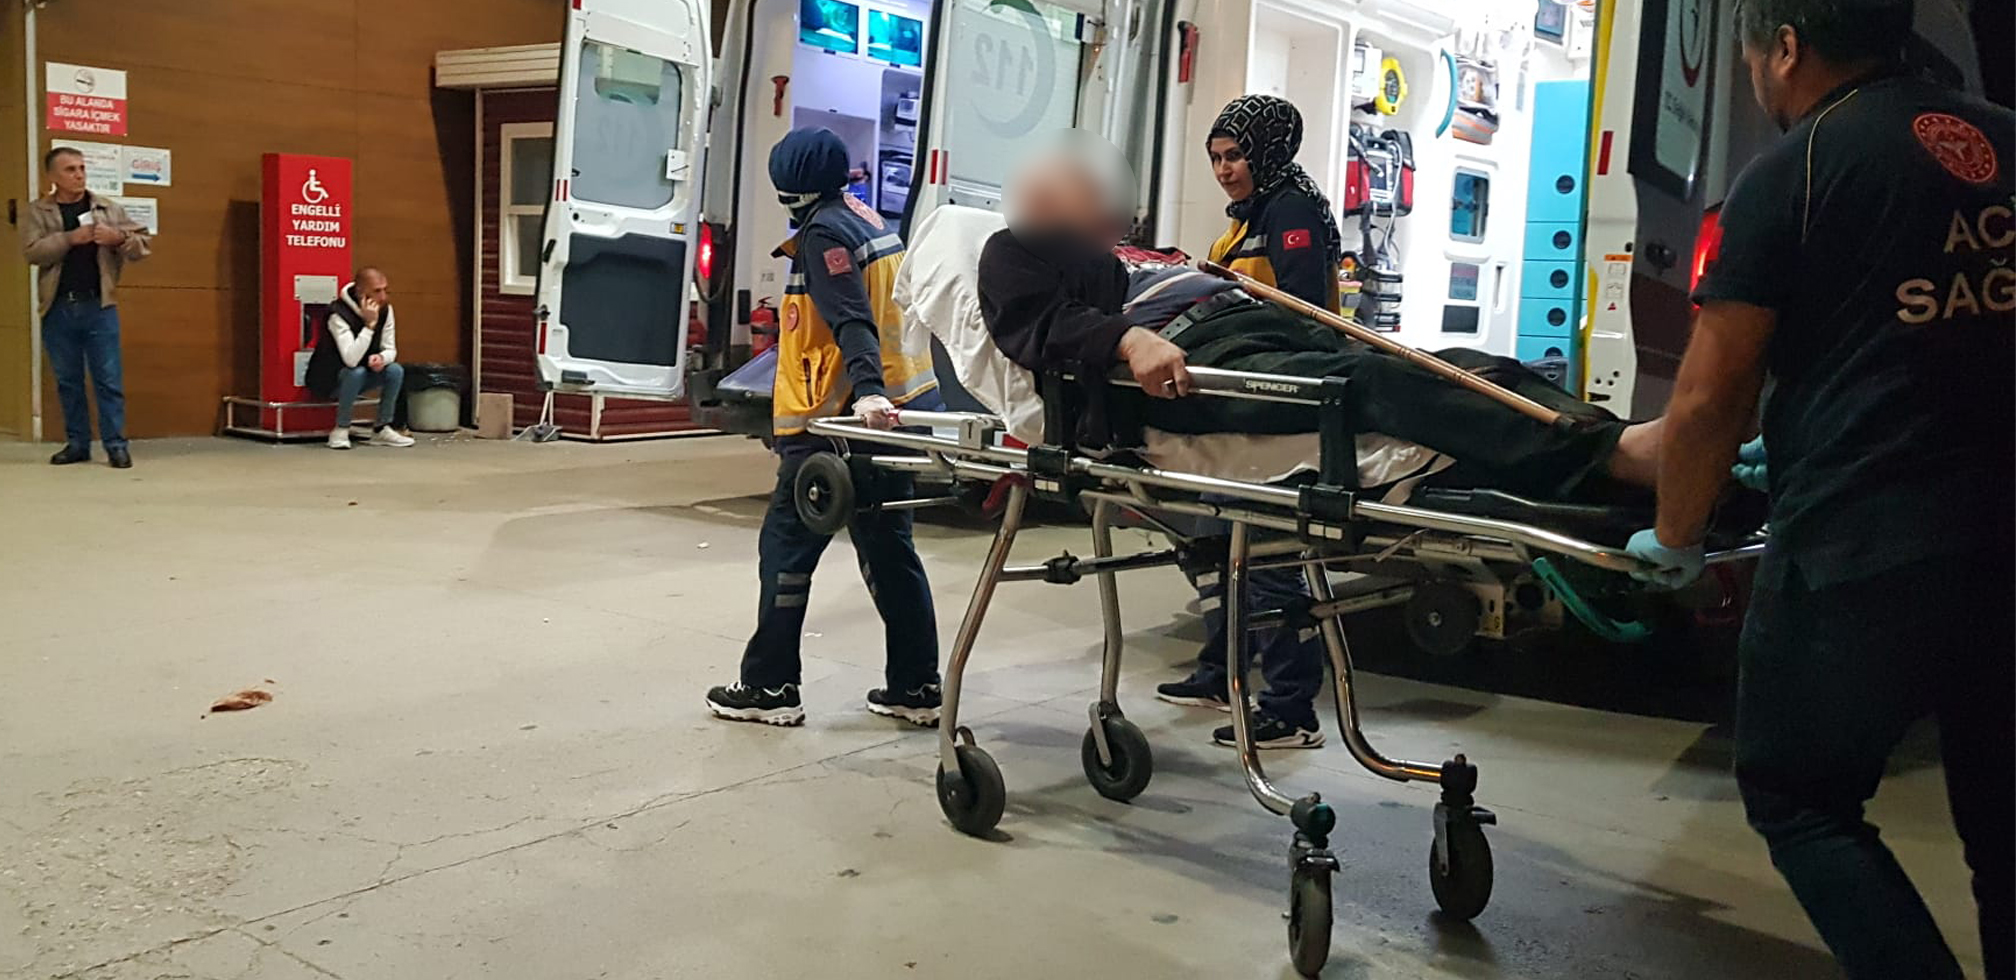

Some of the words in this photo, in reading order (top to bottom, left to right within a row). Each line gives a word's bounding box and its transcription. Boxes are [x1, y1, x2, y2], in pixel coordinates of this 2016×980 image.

[60, 95, 74, 105] BU
[75, 97, 114, 109] ALANDA
[53, 107, 90, 119] SİGARA
[91, 110, 121, 123] İÇMEK
[64, 120, 111, 133] YASAKTIR
[291, 203, 341, 217] ENGELLİ
[292, 219, 340, 233] YARDIM
[1943, 205, 2016, 254] AC
[285, 234, 346, 248] TELEFONU
[1896, 258, 2016, 324] SAĞ
[1245, 379, 1299, 394] SPENCER
